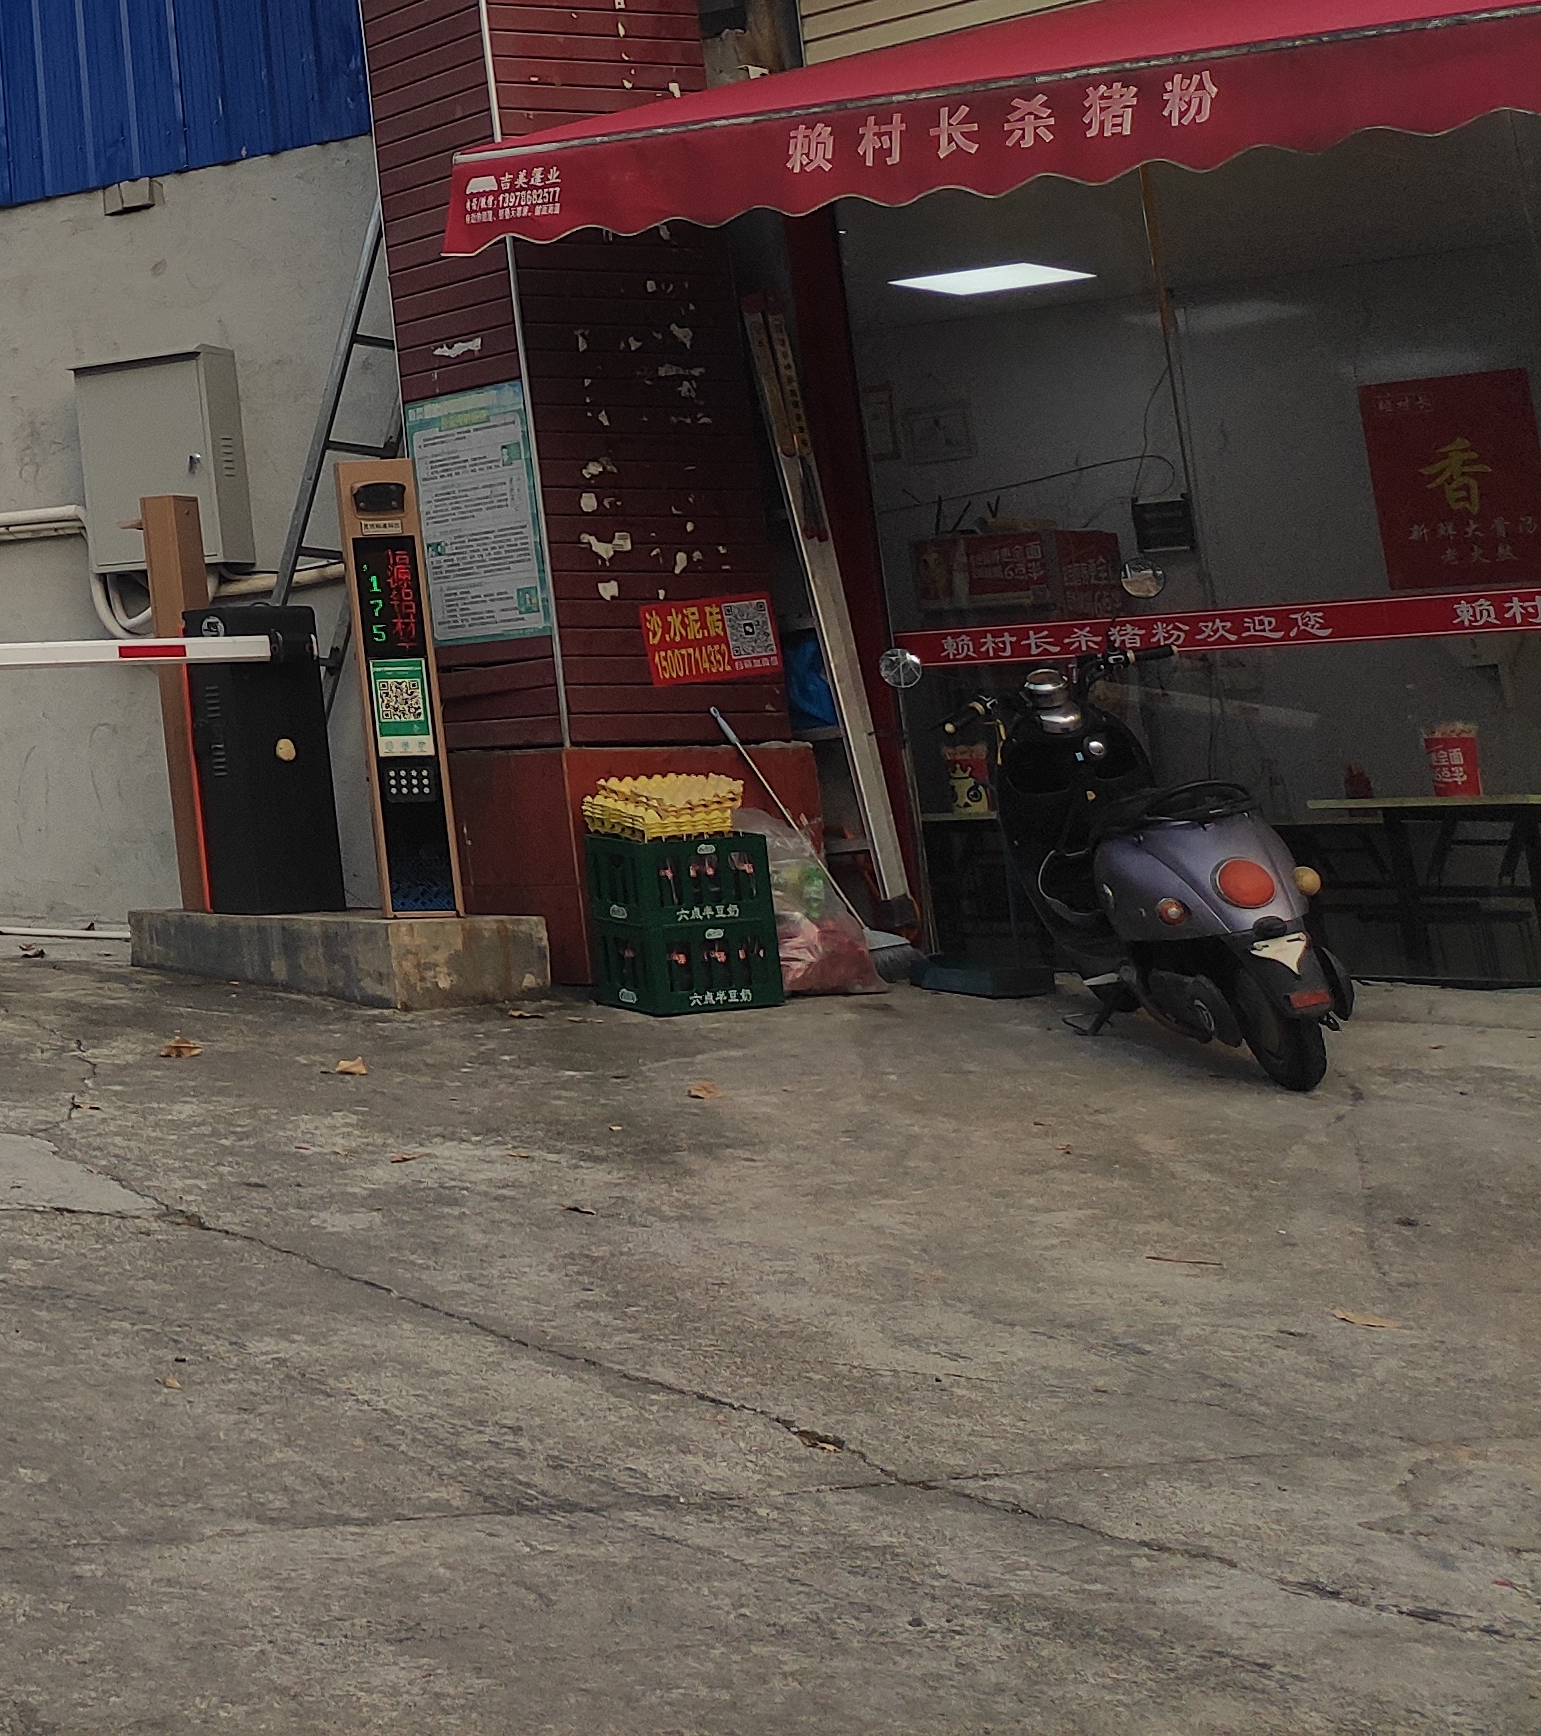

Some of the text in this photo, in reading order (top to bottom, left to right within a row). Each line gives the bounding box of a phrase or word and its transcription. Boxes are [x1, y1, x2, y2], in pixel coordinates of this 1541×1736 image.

[786, 71, 1218, 174] 赖村长杀猪粉
[1418, 436, 1493, 514] 香
[940, 610, 1334, 660] 赖村长杀猪粉欢迎您
